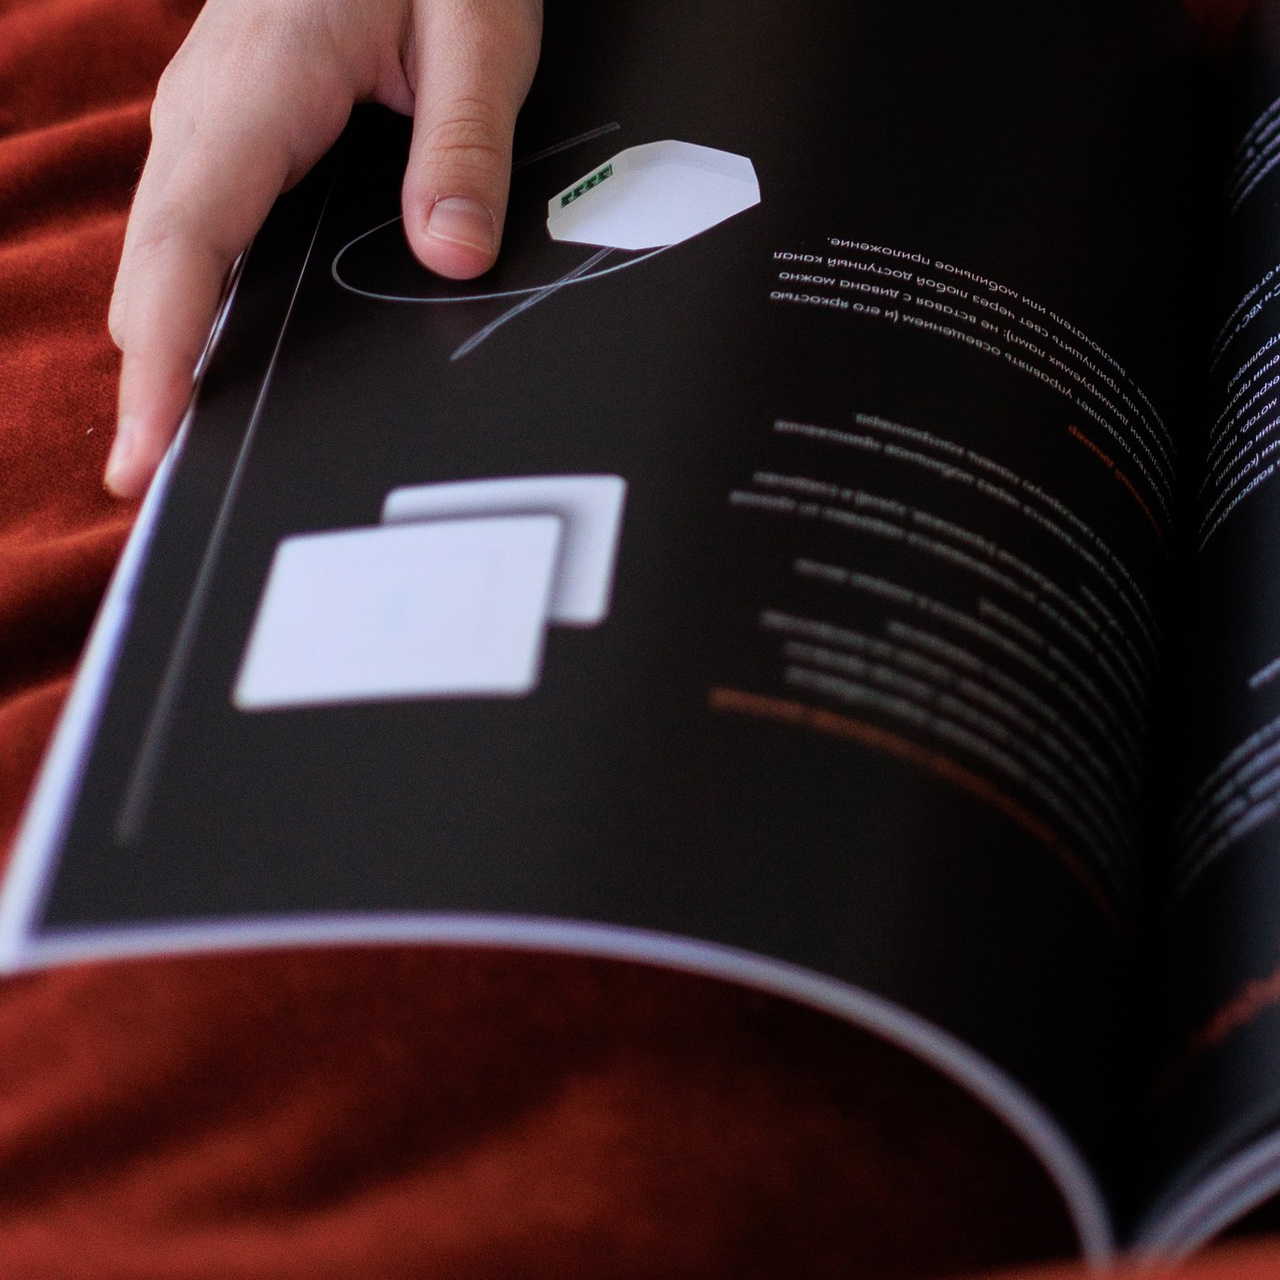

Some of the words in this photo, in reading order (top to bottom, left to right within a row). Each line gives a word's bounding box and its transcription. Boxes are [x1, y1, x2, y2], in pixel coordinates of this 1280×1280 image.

[774, 252, 822, 263] канал
[827, 238, 930, 265] приложение.
[779, 272, 835, 285] можно
[827, 258, 912, 280] доступный
[935, 261, 1018, 298] мобильное
[1261, 271, 1274, 285] от
[840, 280, 899, 298] дивана
[903, 293, 912, 301] с
[917, 277, 968, 298] любой
[1265, 292, 1272, 301] и
[770, 291, 848, 308] яркостью
[853, 303, 880, 315] его
[916, 297, 976, 323] вставая
[973, 295, 1015, 319] через
[1022, 296, 1046, 314] или
[885, 310, 898, 322] (и
[1242, 300, 1263, 327] ХВС
[903, 314, 1001, 356] освещением
[981, 320, 998, 333] не
[1019, 317, 1048, 337] свет
[1003, 330, 1045, 357] ламп):
[1050, 312, 1125, 377] выключатель
[1052, 335, 1120, 393] приглушить
[1005, 353, 1072, 398] управлять
[1049, 355, 1128, 425] диммируемых
[1122, 393, 1139, 415] или
[1076, 398, 1131, 453] позволяет
[1216, 440, 1253, 486] сигнала
